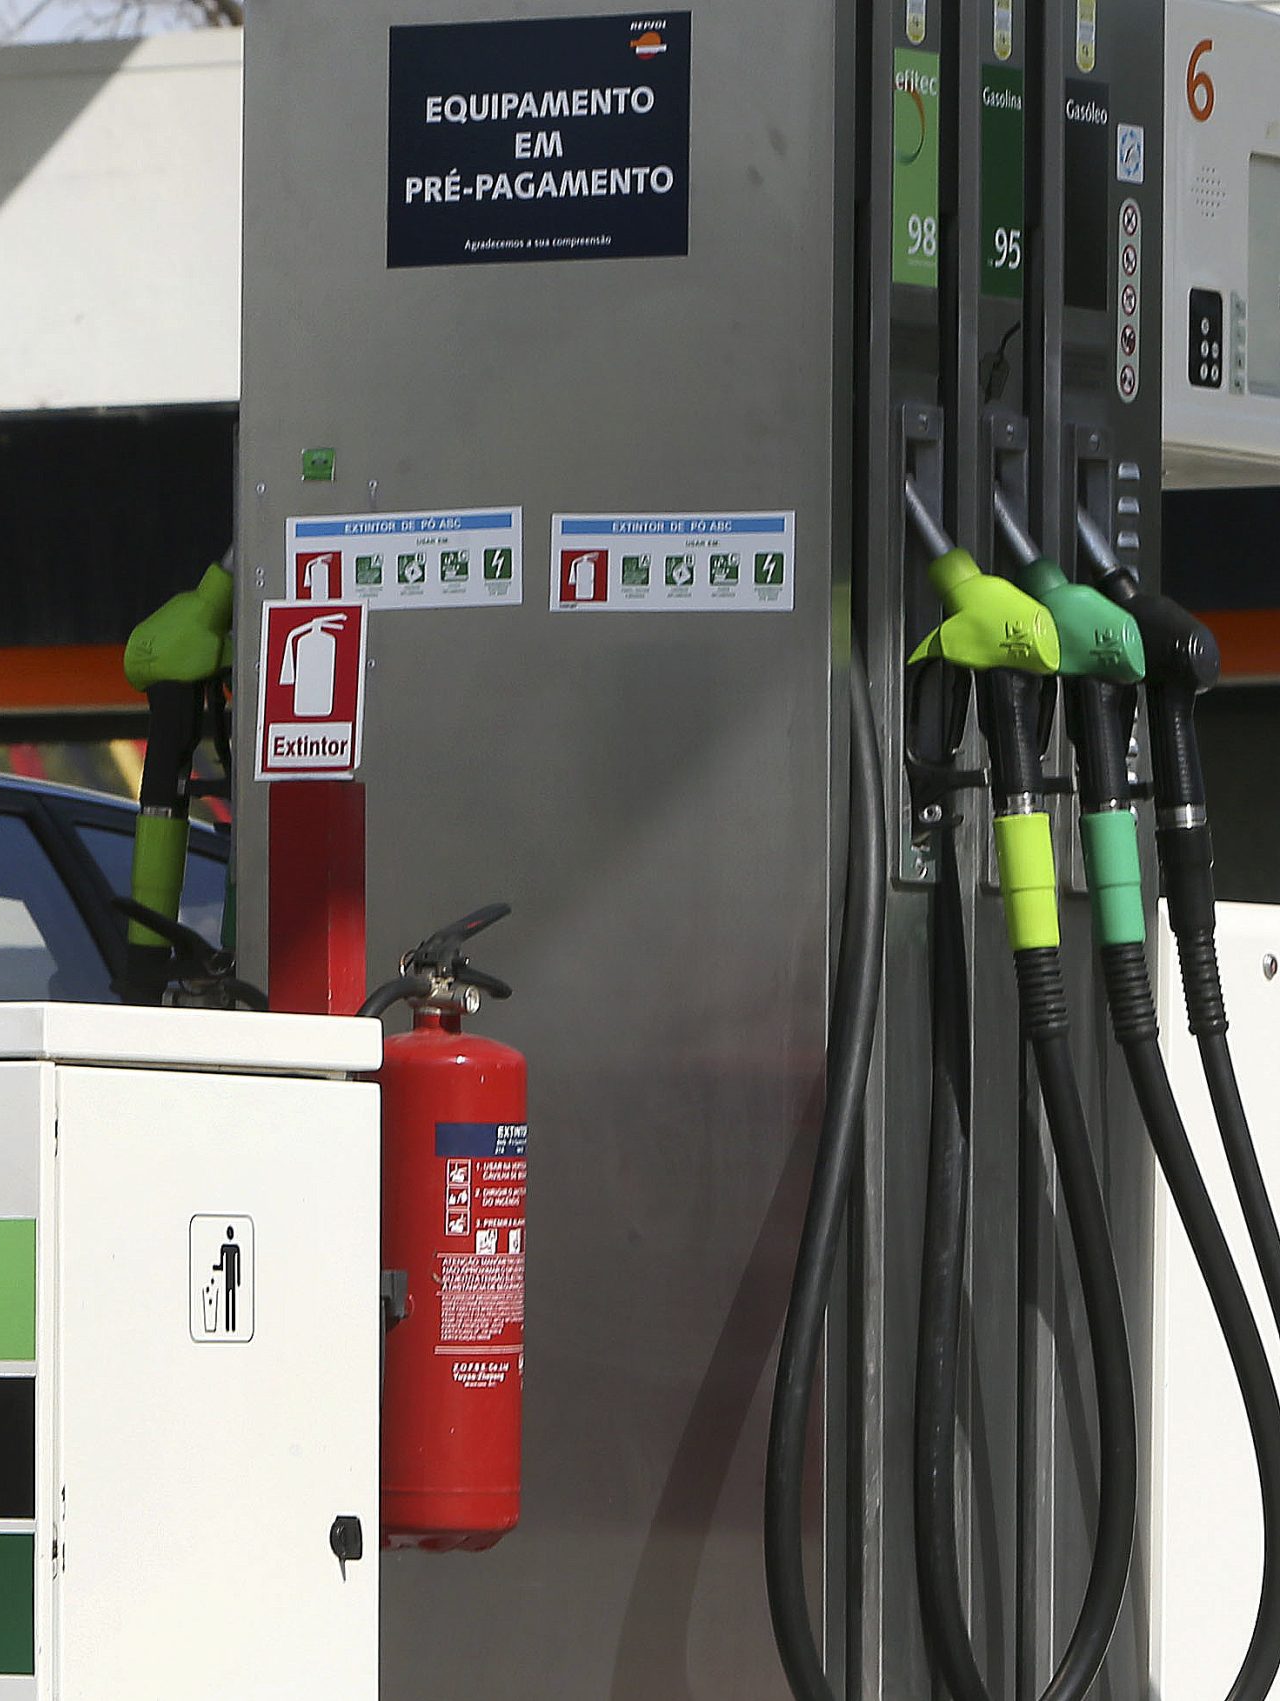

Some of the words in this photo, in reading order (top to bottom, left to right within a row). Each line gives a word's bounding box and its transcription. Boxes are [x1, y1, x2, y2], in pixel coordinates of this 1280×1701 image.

[895, 69, 938, 97] efitec
[1186, 39, 1215, 122] 6
[425, 86, 655, 124] EQUIPAMENTO
[982, 86, 1022, 110] Gasolina
[1066, 98, 1108, 125] Gasóleo
[514, 130, 563, 160] EM
[405, 165, 674, 205] PRÉ-PAGAMENTO
[464, 237, 524, 252] Agradecemos
[526, 238, 532, 248] a
[534, 237, 550, 247] sua
[552, 233, 612, 249] compreensão
[907, 213, 936, 257] 98
[994, 226, 1021, 270] 95
[344, 520, 396, 534] EXTINTOR
[401, 519, 415, 532] DE
[421, 516, 437, 531] PÓ
[612, 520, 665, 533] EXTINTOR
[670, 520, 684, 533] DE
[273, 735, 348, 756] Extintor
